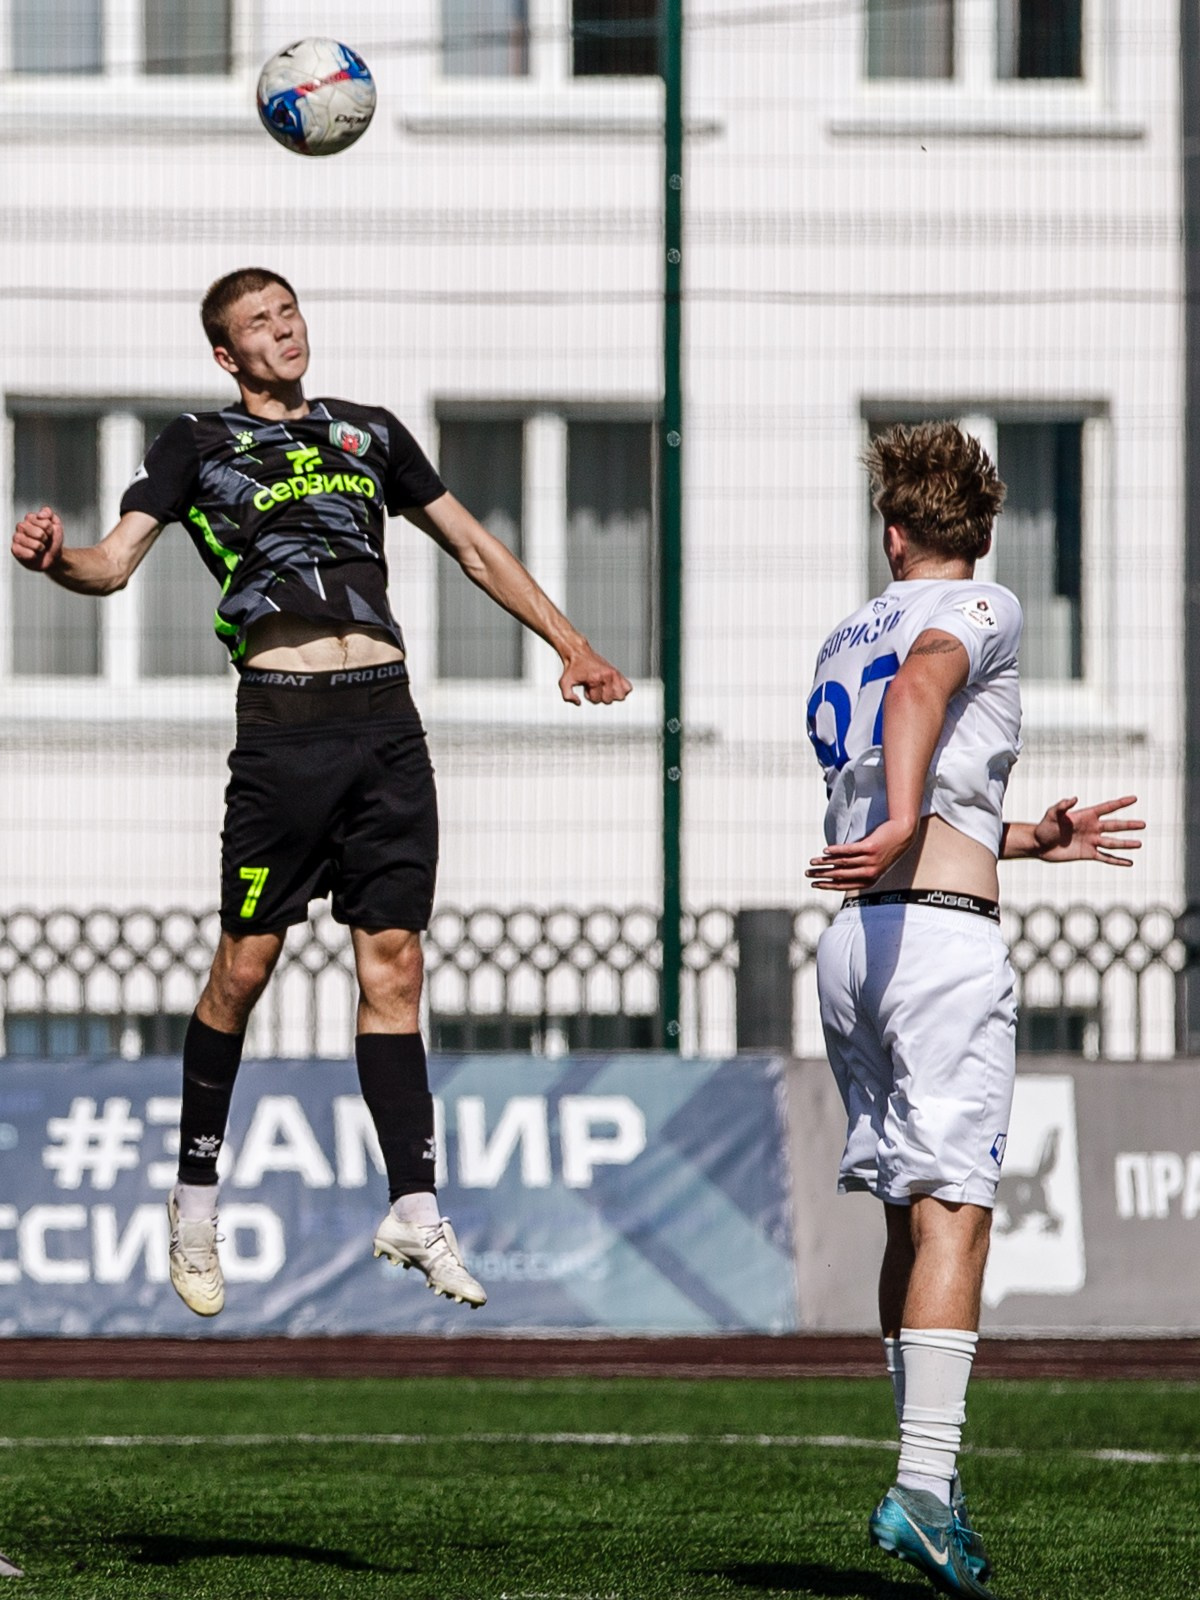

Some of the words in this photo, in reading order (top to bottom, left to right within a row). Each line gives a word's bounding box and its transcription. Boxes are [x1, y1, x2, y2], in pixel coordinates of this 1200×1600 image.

[243, 671, 313, 687] OMBAT
[330, 671, 373, 686] PRO
[239, 866, 270, 919] 7
[917, 891, 980, 911] JÖGEL
